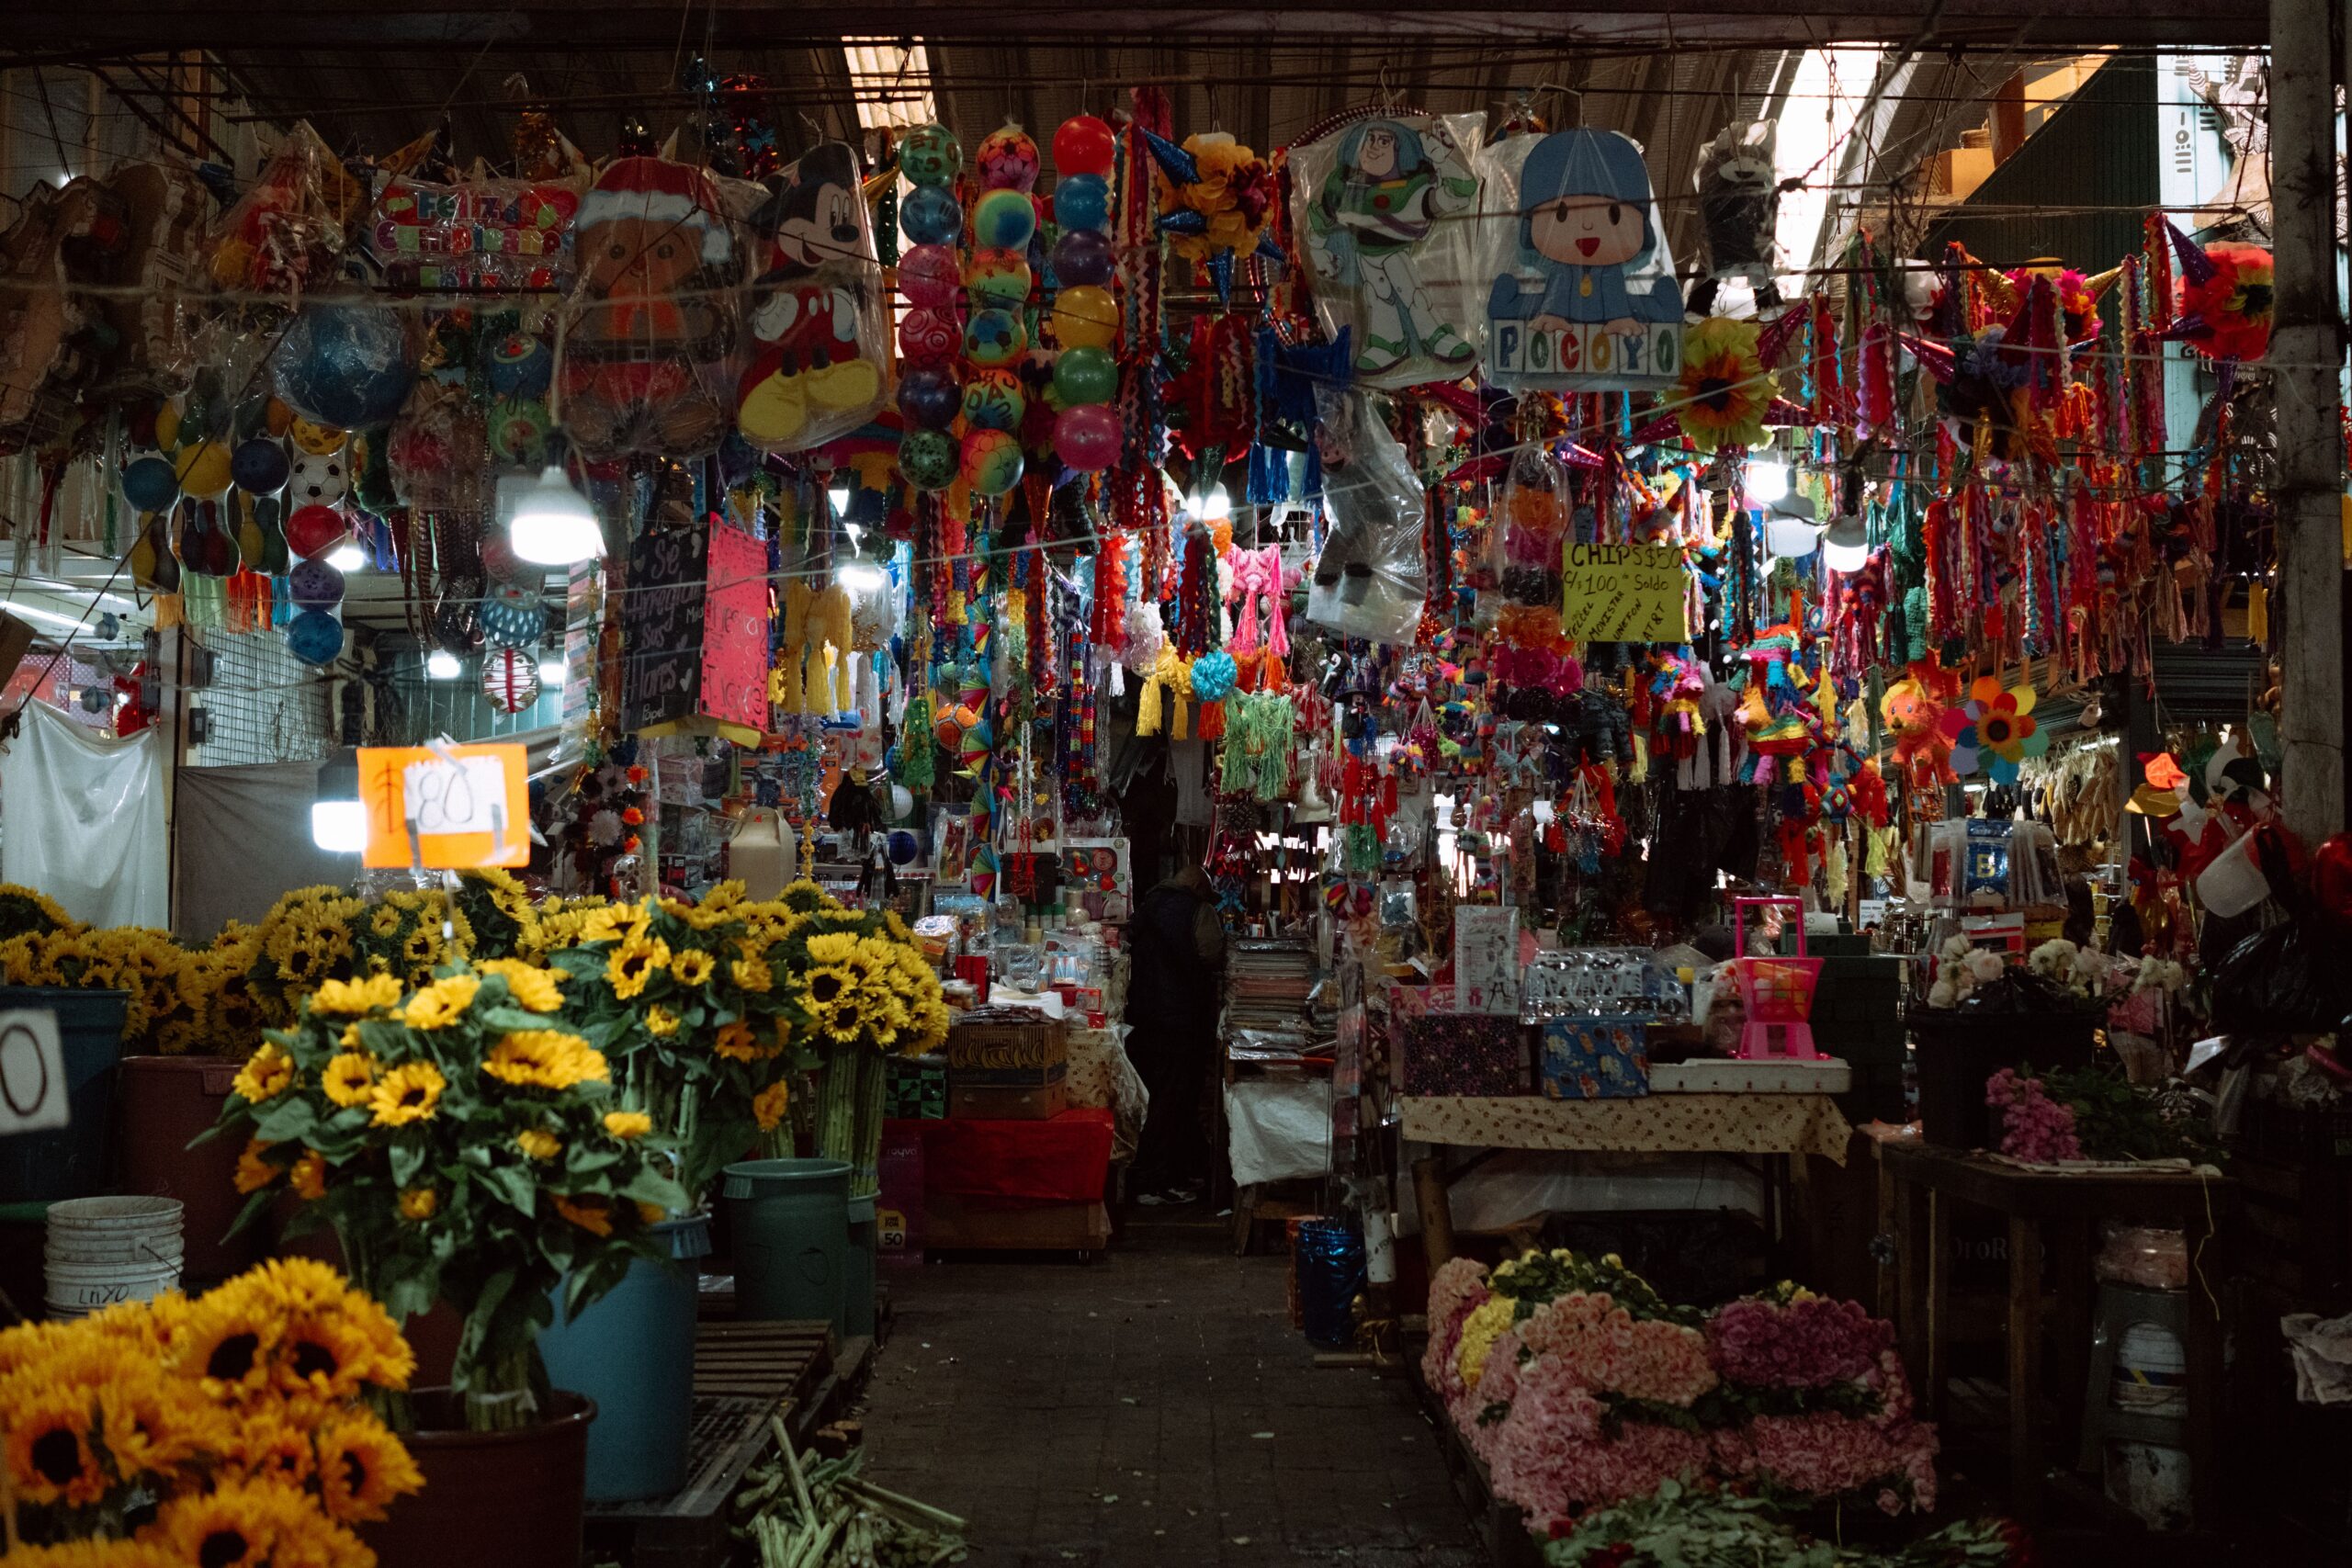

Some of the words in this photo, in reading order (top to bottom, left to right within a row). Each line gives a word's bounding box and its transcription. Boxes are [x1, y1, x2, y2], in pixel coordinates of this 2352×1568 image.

[416, 189, 501, 220] Feliz
[1499, 325, 1675, 373] POCOYO
[1572, 544, 1643, 567] CHIPS
[1645, 547, 1682, 570] $50
[1612, 597, 1643, 640] UNEFON
[1643, 601, 1665, 641] AT&T
[885, 1233, 903, 1246] 50
